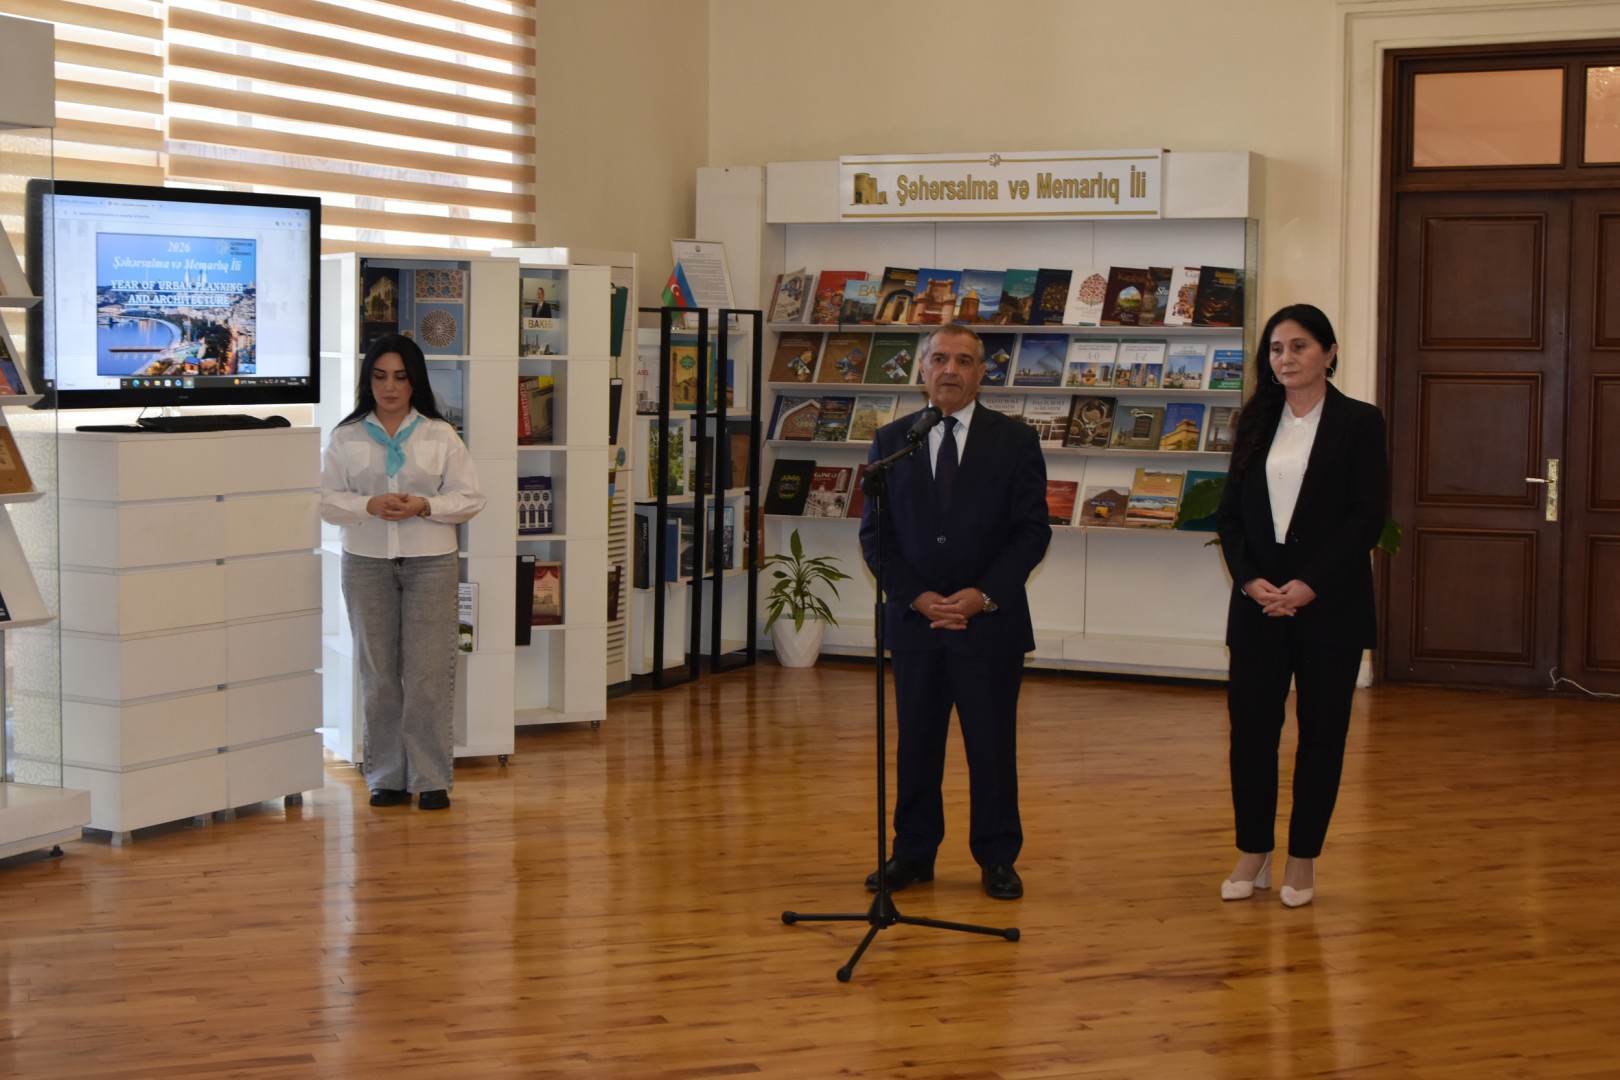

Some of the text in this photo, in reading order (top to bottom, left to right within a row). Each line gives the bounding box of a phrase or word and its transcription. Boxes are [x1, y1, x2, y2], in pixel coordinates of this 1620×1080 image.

[897, 165, 1146, 207] Şəhərsalma və Memarlıq İli
[167, 241, 190, 253] 2026
[112, 256, 242, 273] Şəhərsalma və Memarlıq İli
[111, 279, 243, 292] YEAR OF URBAN PLANNING
[128, 294, 231, 305] AND ARCHITECTURE
[528, 319, 547, 328] BAKI
